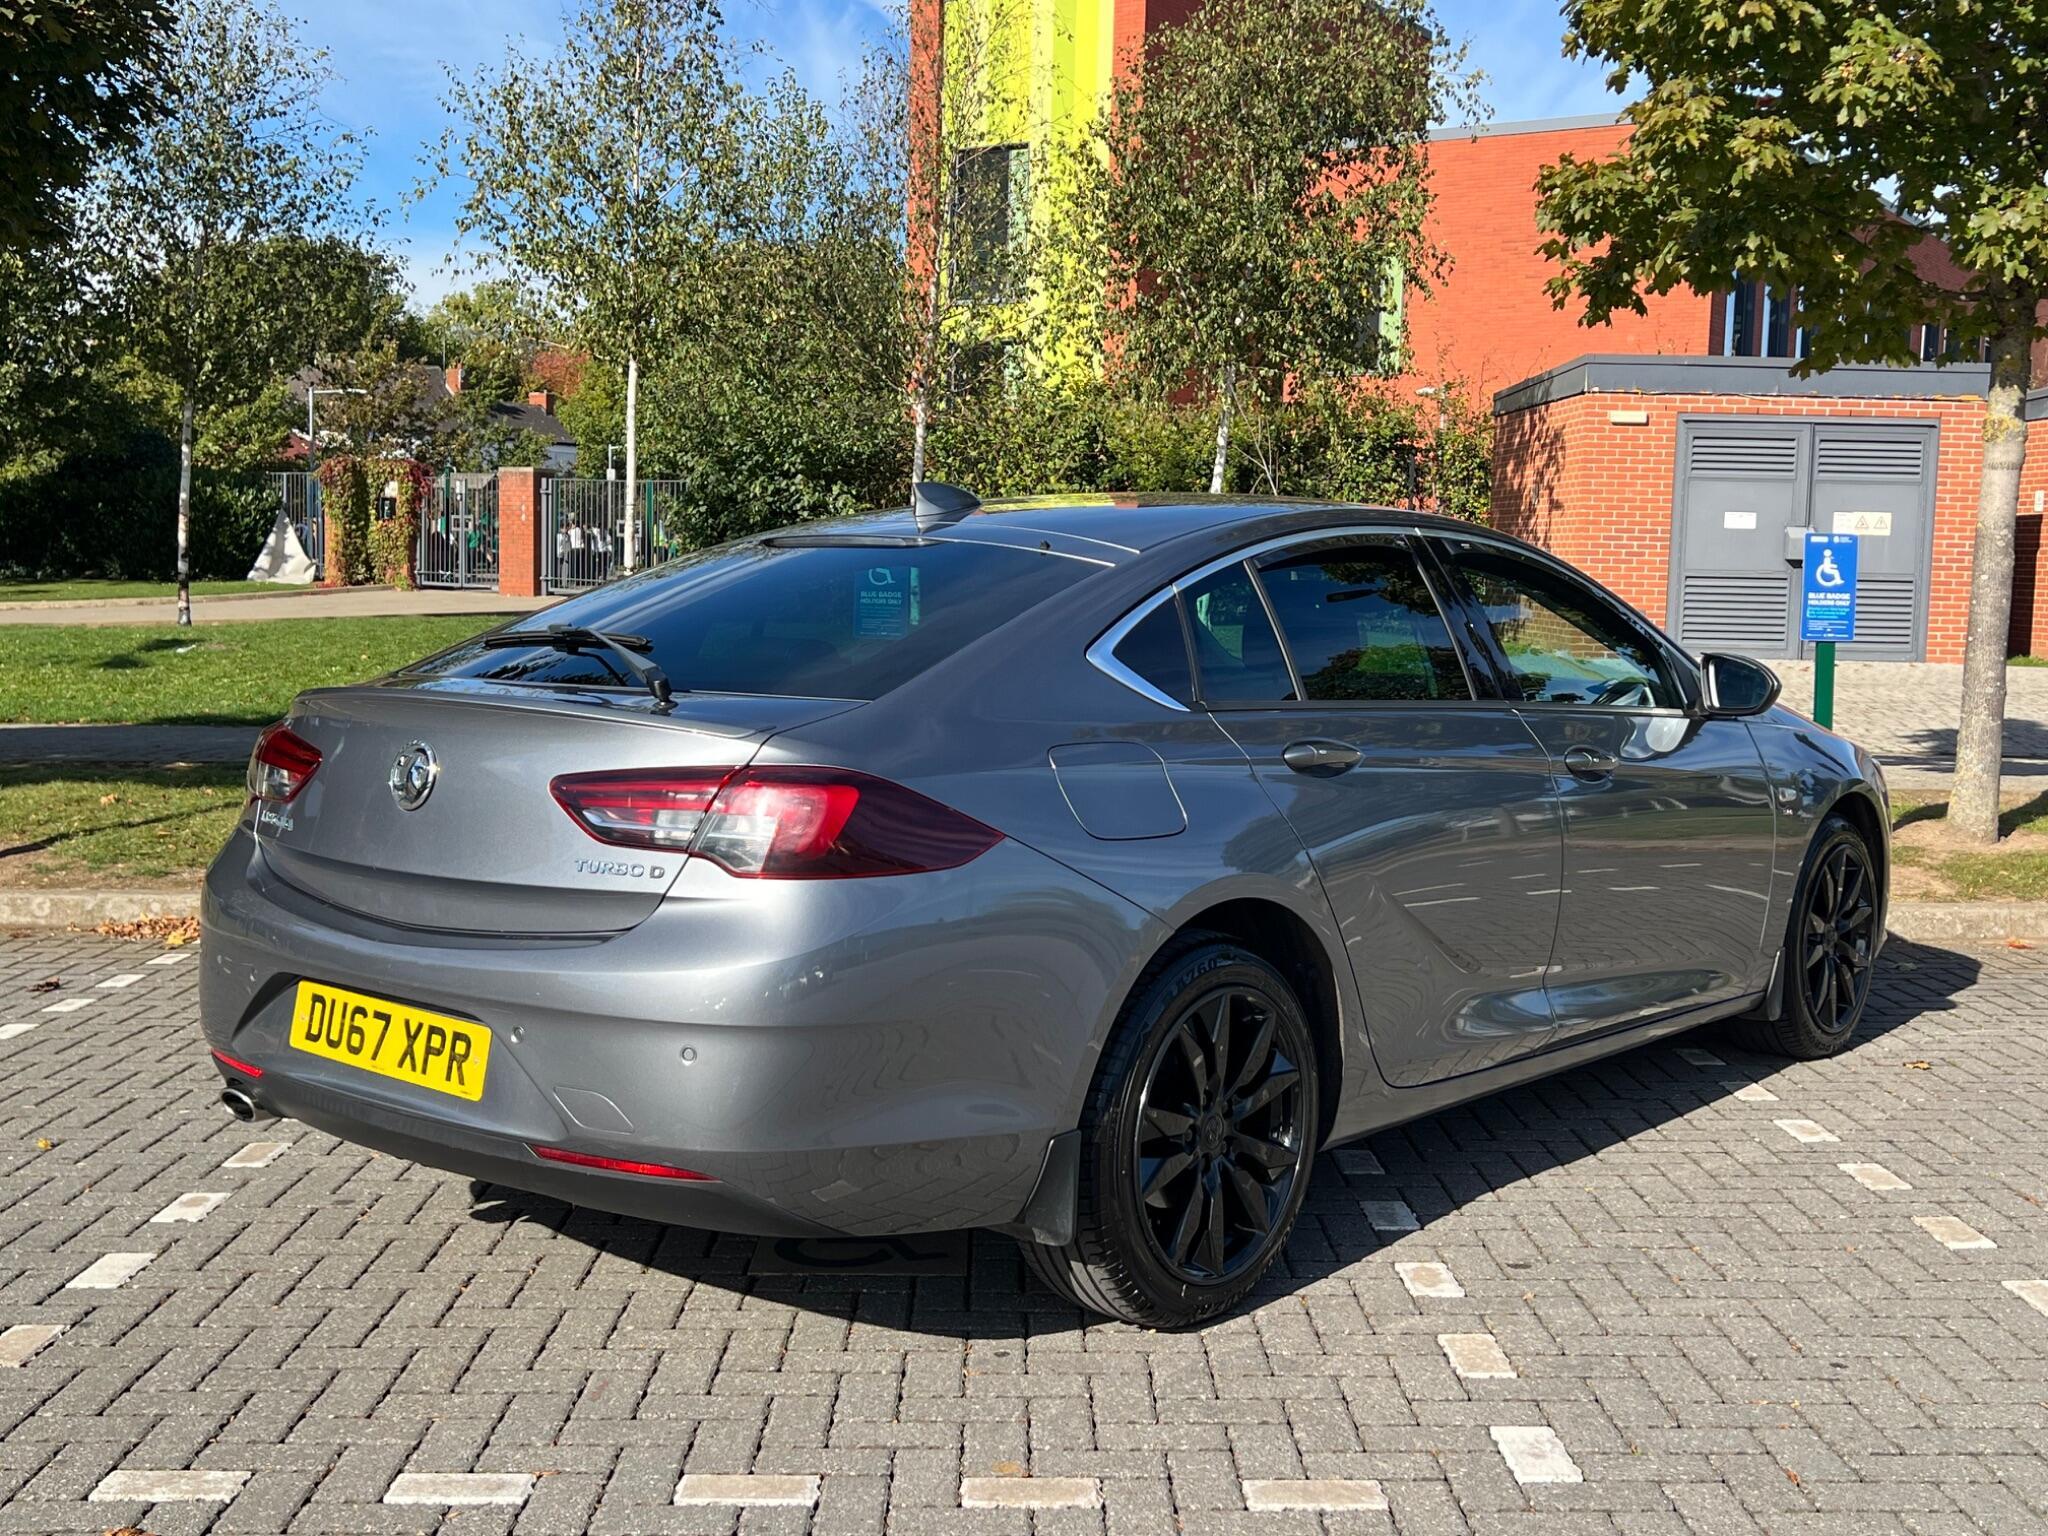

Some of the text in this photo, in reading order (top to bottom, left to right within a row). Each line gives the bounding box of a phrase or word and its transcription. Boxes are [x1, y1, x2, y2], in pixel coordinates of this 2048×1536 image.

[1826, 592, 1851, 600] BADGE
[575, 859, 665, 879] TURBO D
[304, 992, 472, 1087] DU67 XPR
